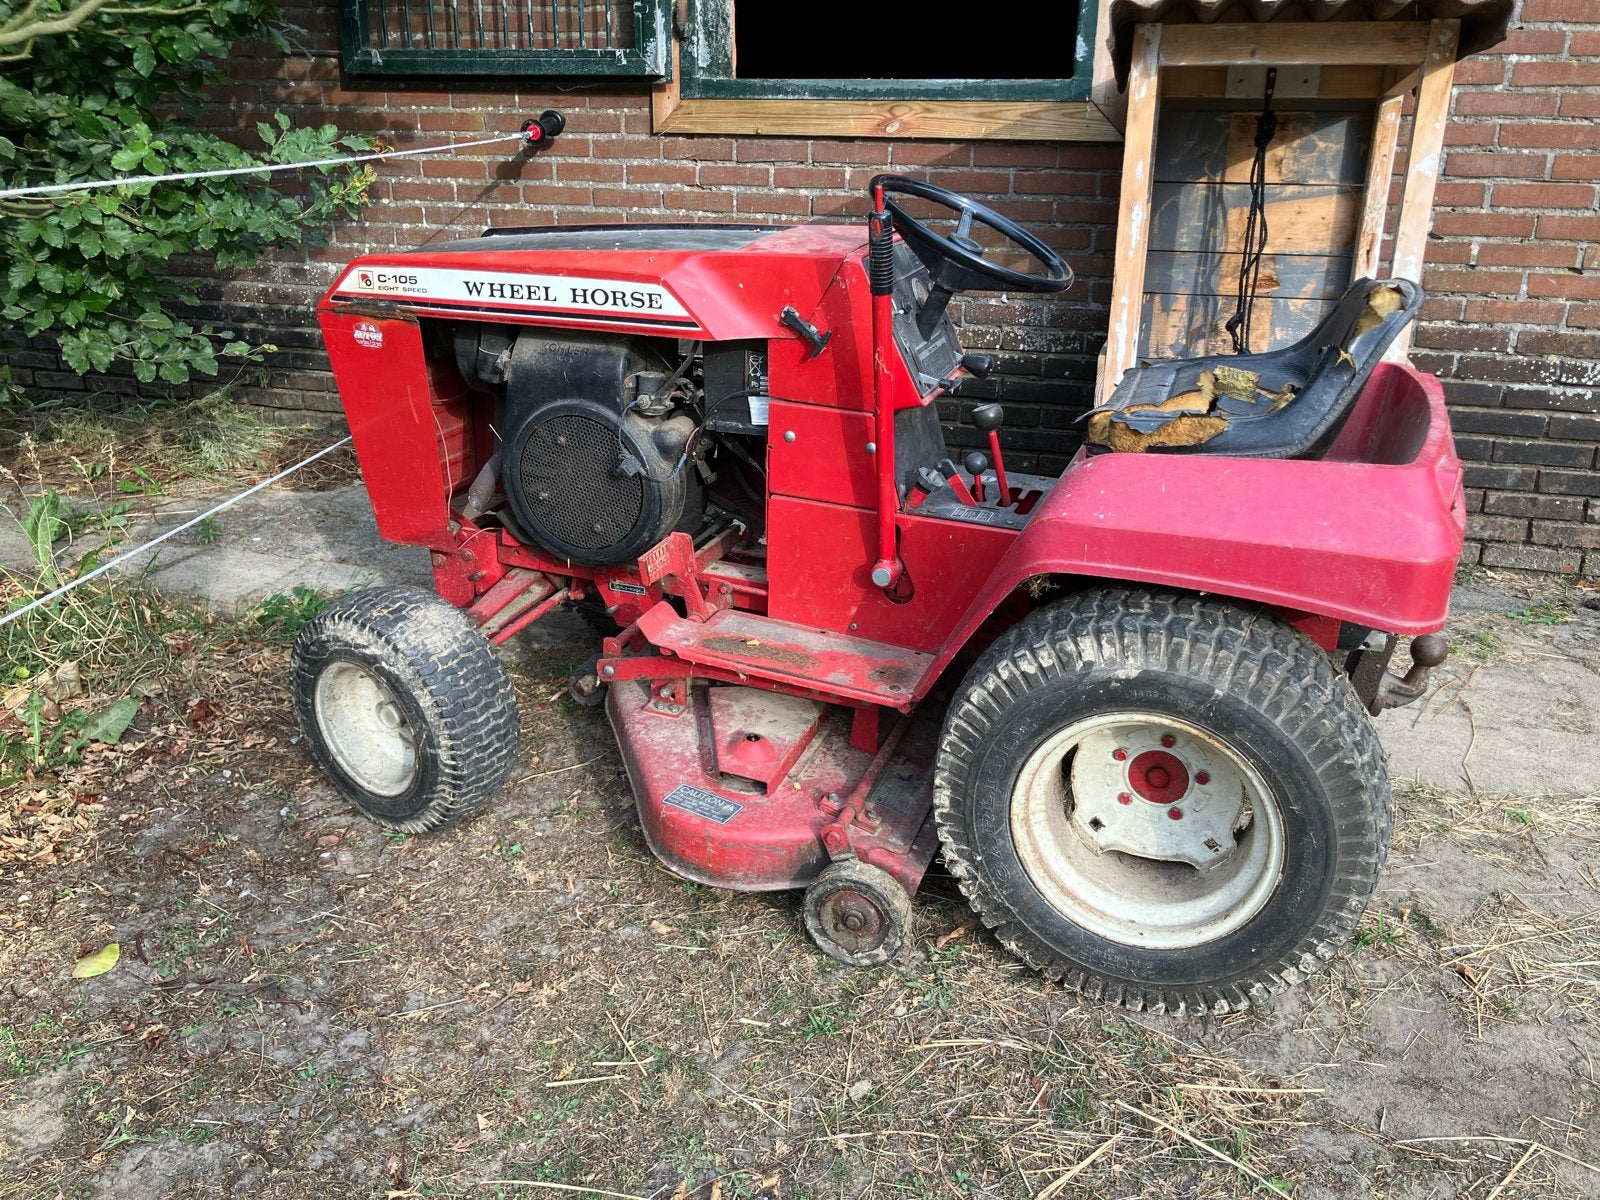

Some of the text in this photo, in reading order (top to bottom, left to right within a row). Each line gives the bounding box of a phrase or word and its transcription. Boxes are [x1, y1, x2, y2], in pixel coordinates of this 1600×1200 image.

[377, 274, 418, 285] C-105
[463, 281, 663, 309] WHEEL HORSE
[542, 341, 590, 357] KOHLER
[751, 380, 760, 388] Pb
[680, 786, 726, 807] CAUTION
